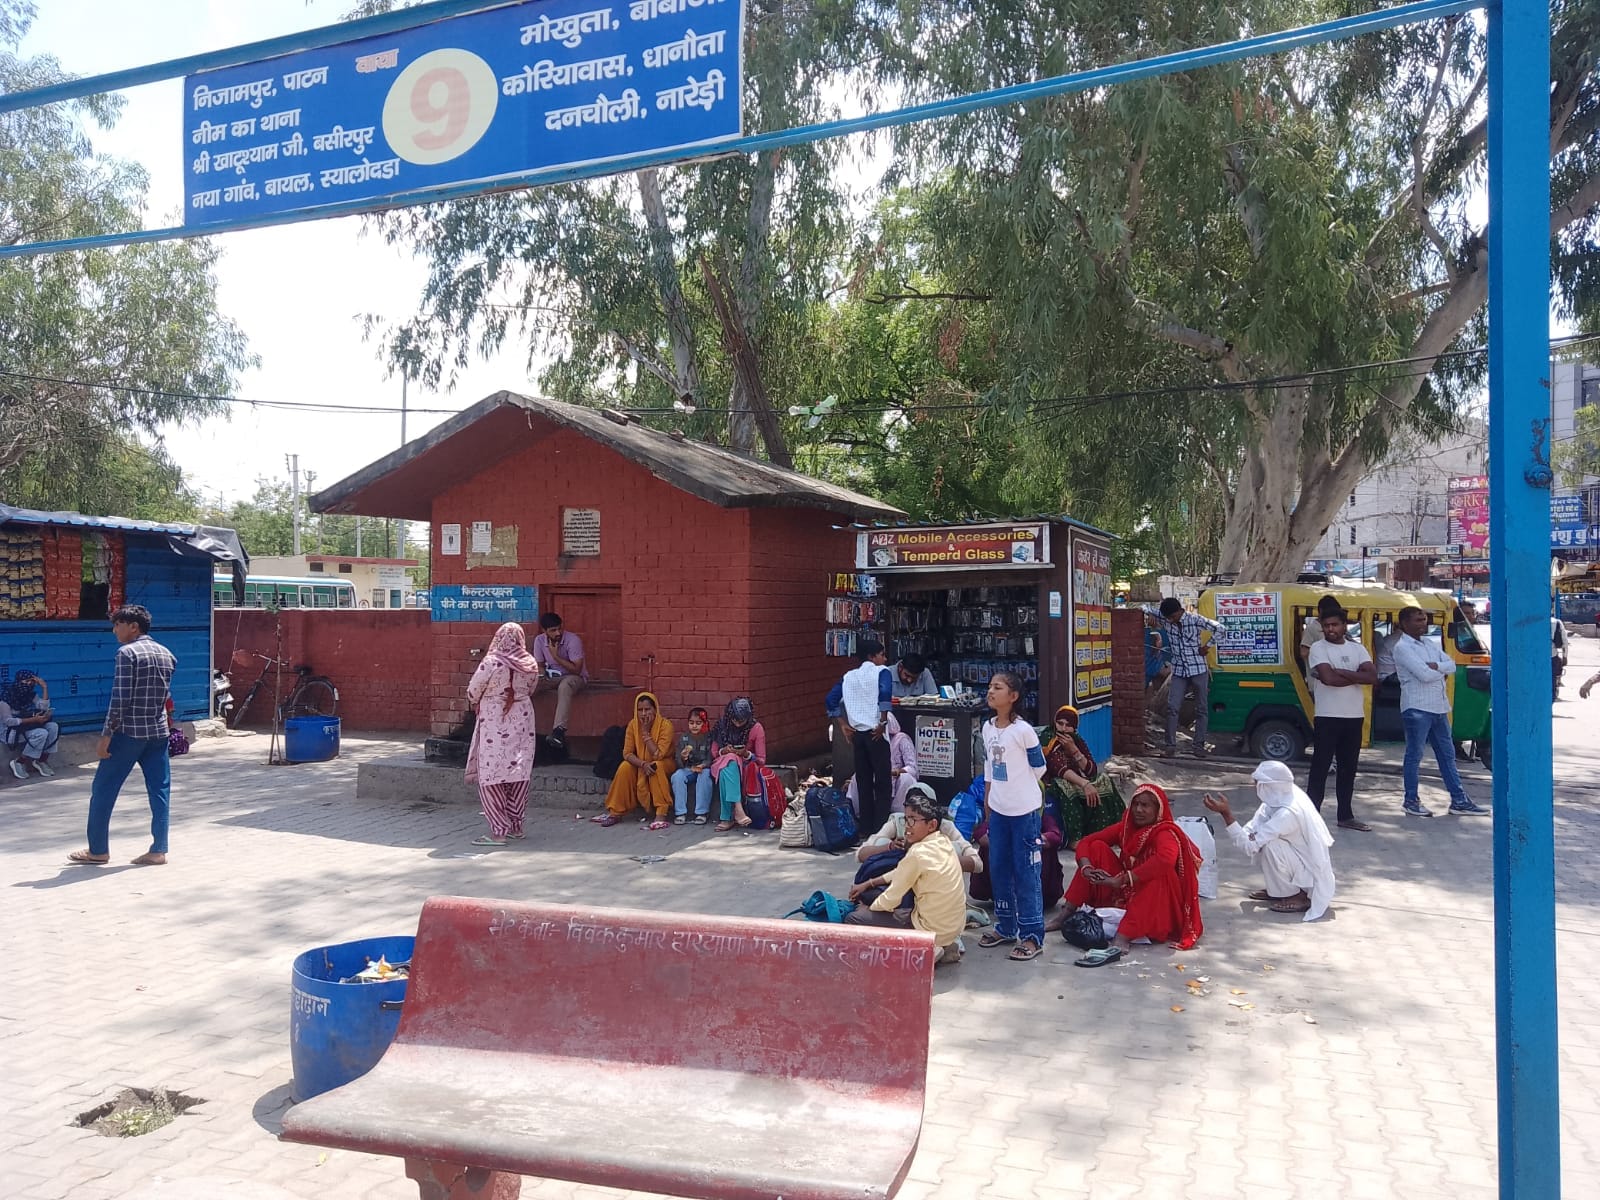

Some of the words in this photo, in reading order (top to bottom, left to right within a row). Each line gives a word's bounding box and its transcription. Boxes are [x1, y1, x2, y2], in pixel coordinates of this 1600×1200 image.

[520, 8, 620, 48] मोखुता,
[355, 48, 400, 73] वाया
[502, 54, 633, 96] कोरियावास,
[193, 78, 277, 110] निजामपुर,
[283, 66, 329, 91] पाटन
[411, 67, 470, 150] 9
[192, 121, 227, 145] नीम
[231, 118, 256, 137] का
[260, 109, 301, 131] थाना
[193, 151, 211, 174] श्री
[213, 143, 279, 174] खाटूश्याम
[281, 132, 308, 156] जी,
[313, 125, 375, 155] बसीरपुर
[192, 189, 221, 208] नया
[224, 178, 260, 202] गांव,
[265, 173, 314, 195] बायल,
[898, 534, 942, 545] Mobile
[946, 531, 1034, 542] Accessories
[902, 550, 960, 563] Temperd
[965, 548, 1005, 560] Glass
[440, 597, 456, 609] पीने
[458, 600, 469, 609] का
[496, 598, 518, 609] पानी
[1218, 594, 1274, 606] स्पर्श
[1227, 631, 1254, 640] ECHS
[919, 729, 951, 739] HOTEL
